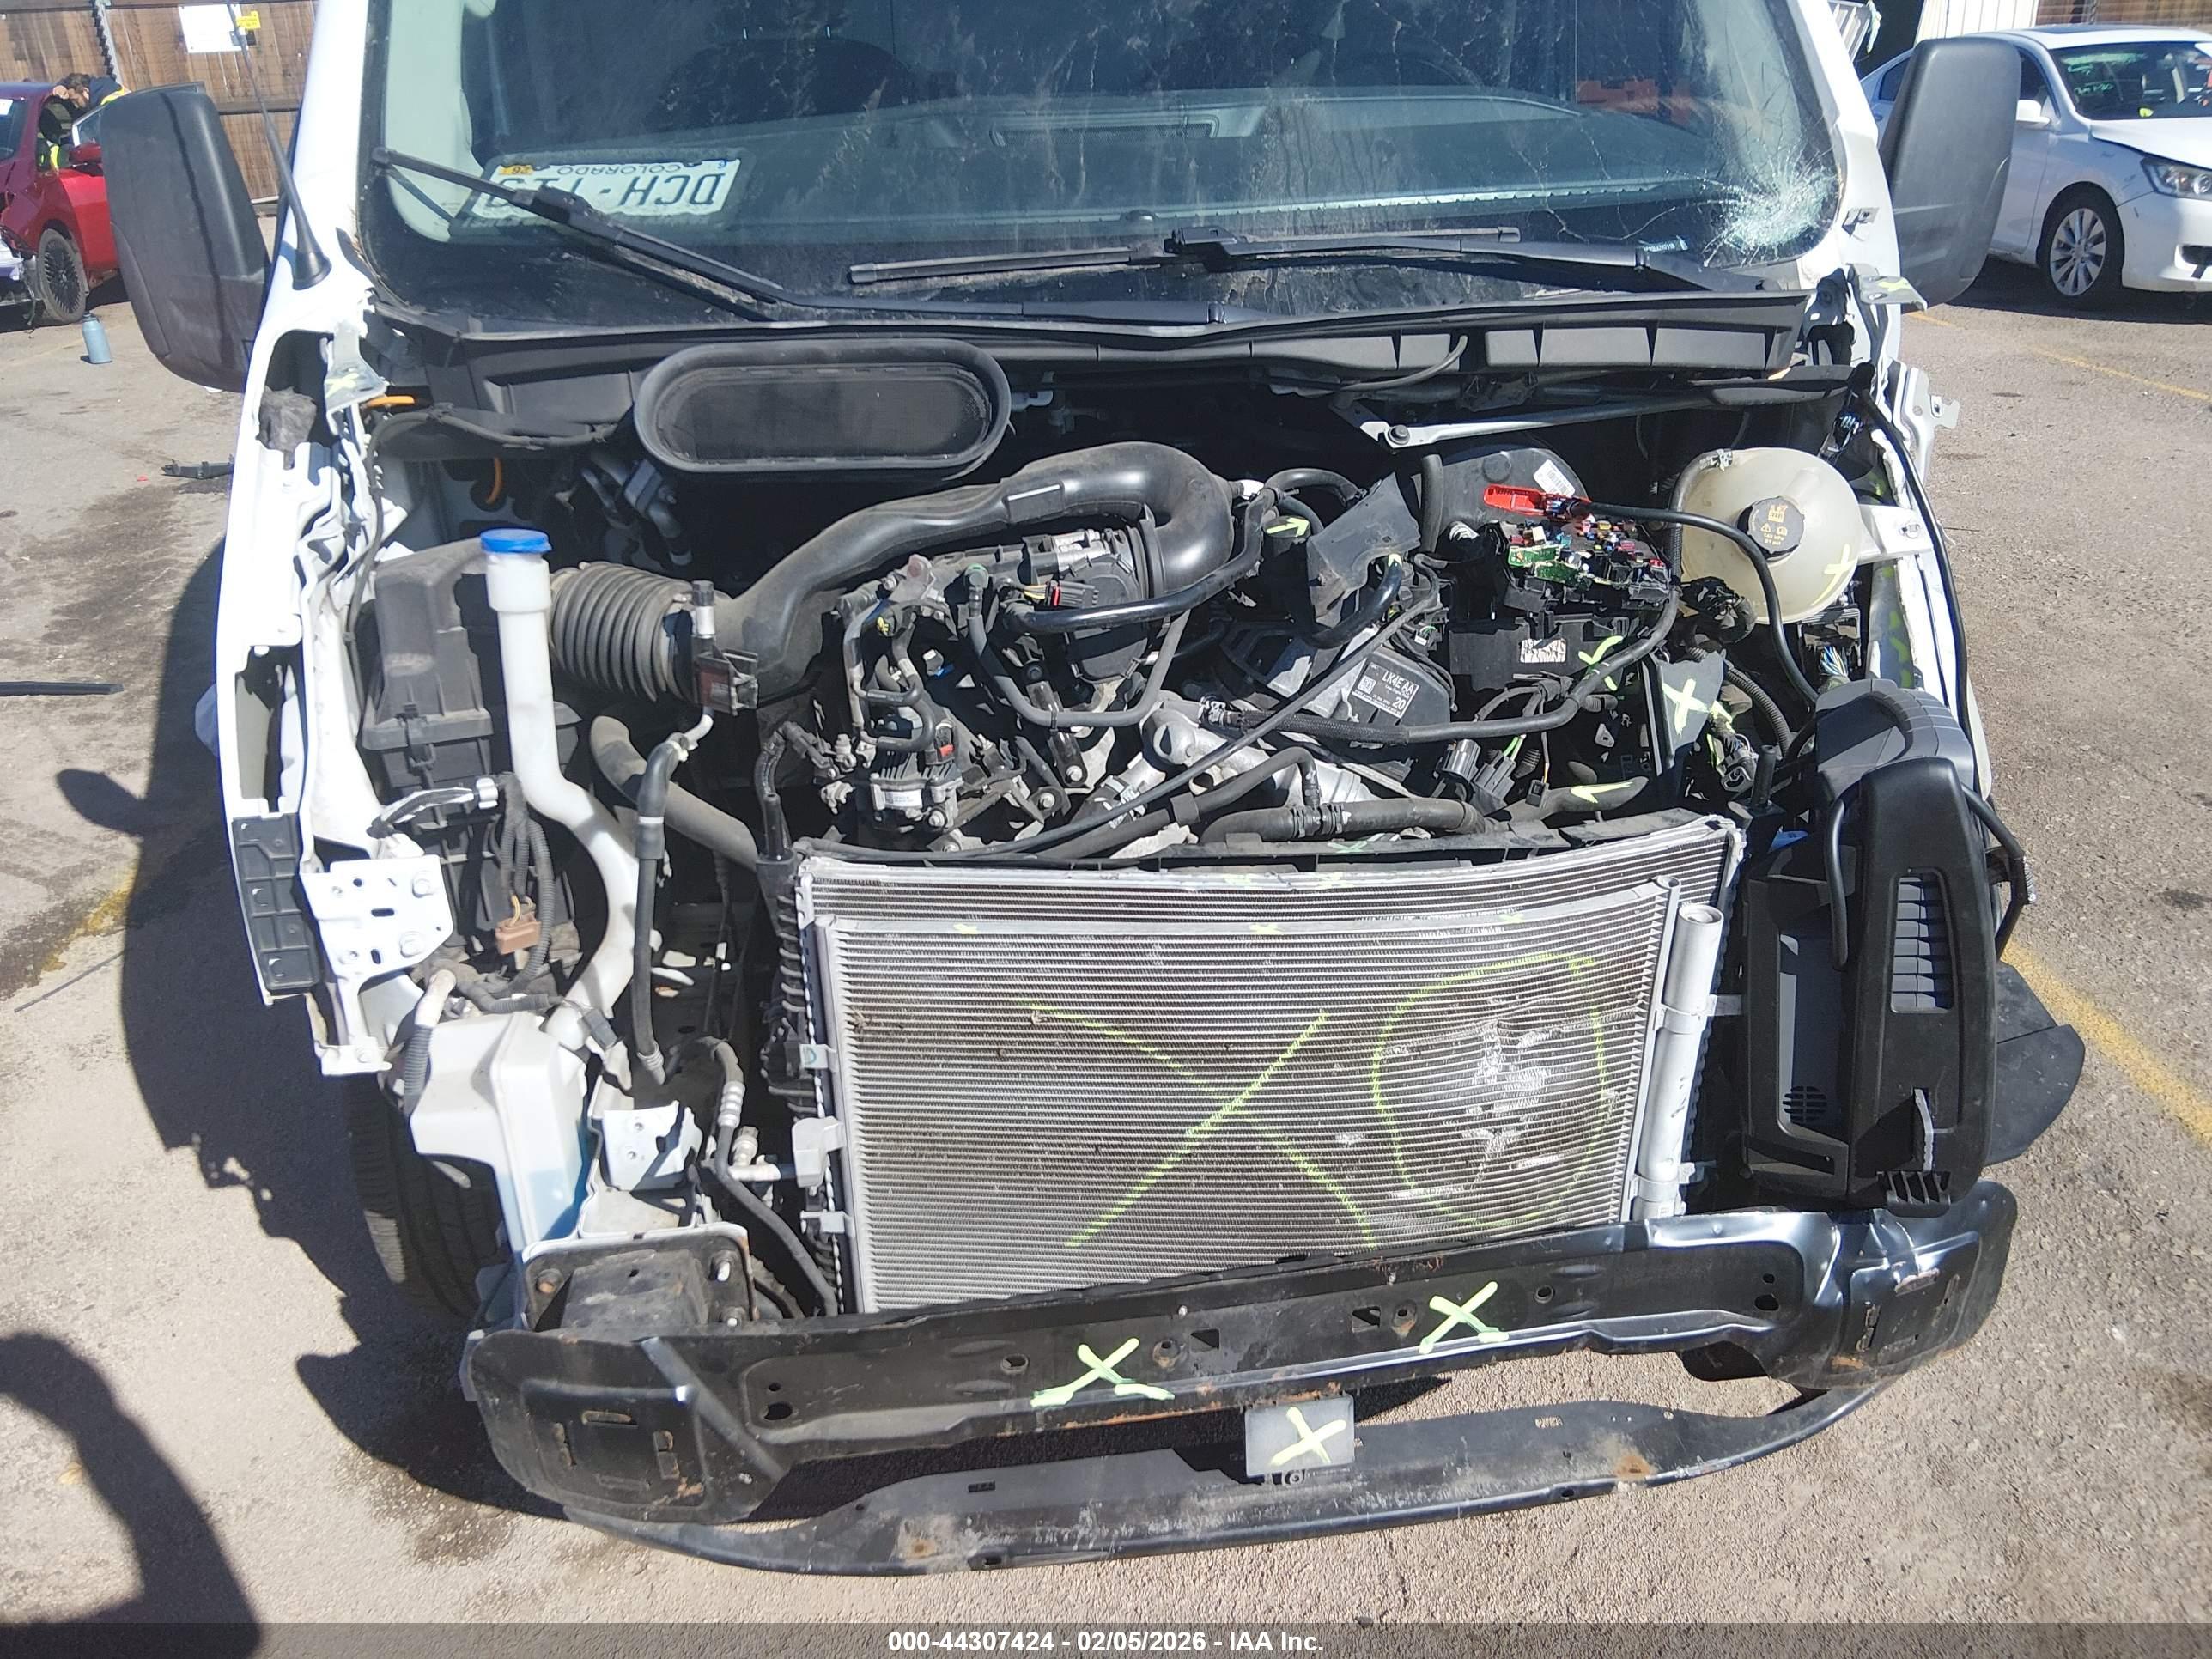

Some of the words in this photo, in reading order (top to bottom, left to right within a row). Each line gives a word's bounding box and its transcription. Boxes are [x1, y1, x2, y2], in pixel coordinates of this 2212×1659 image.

[557, 163, 681, 175] COLORADO
[487, 173, 726, 208] DCH-
[1392, 696, 1407, 710] 20
